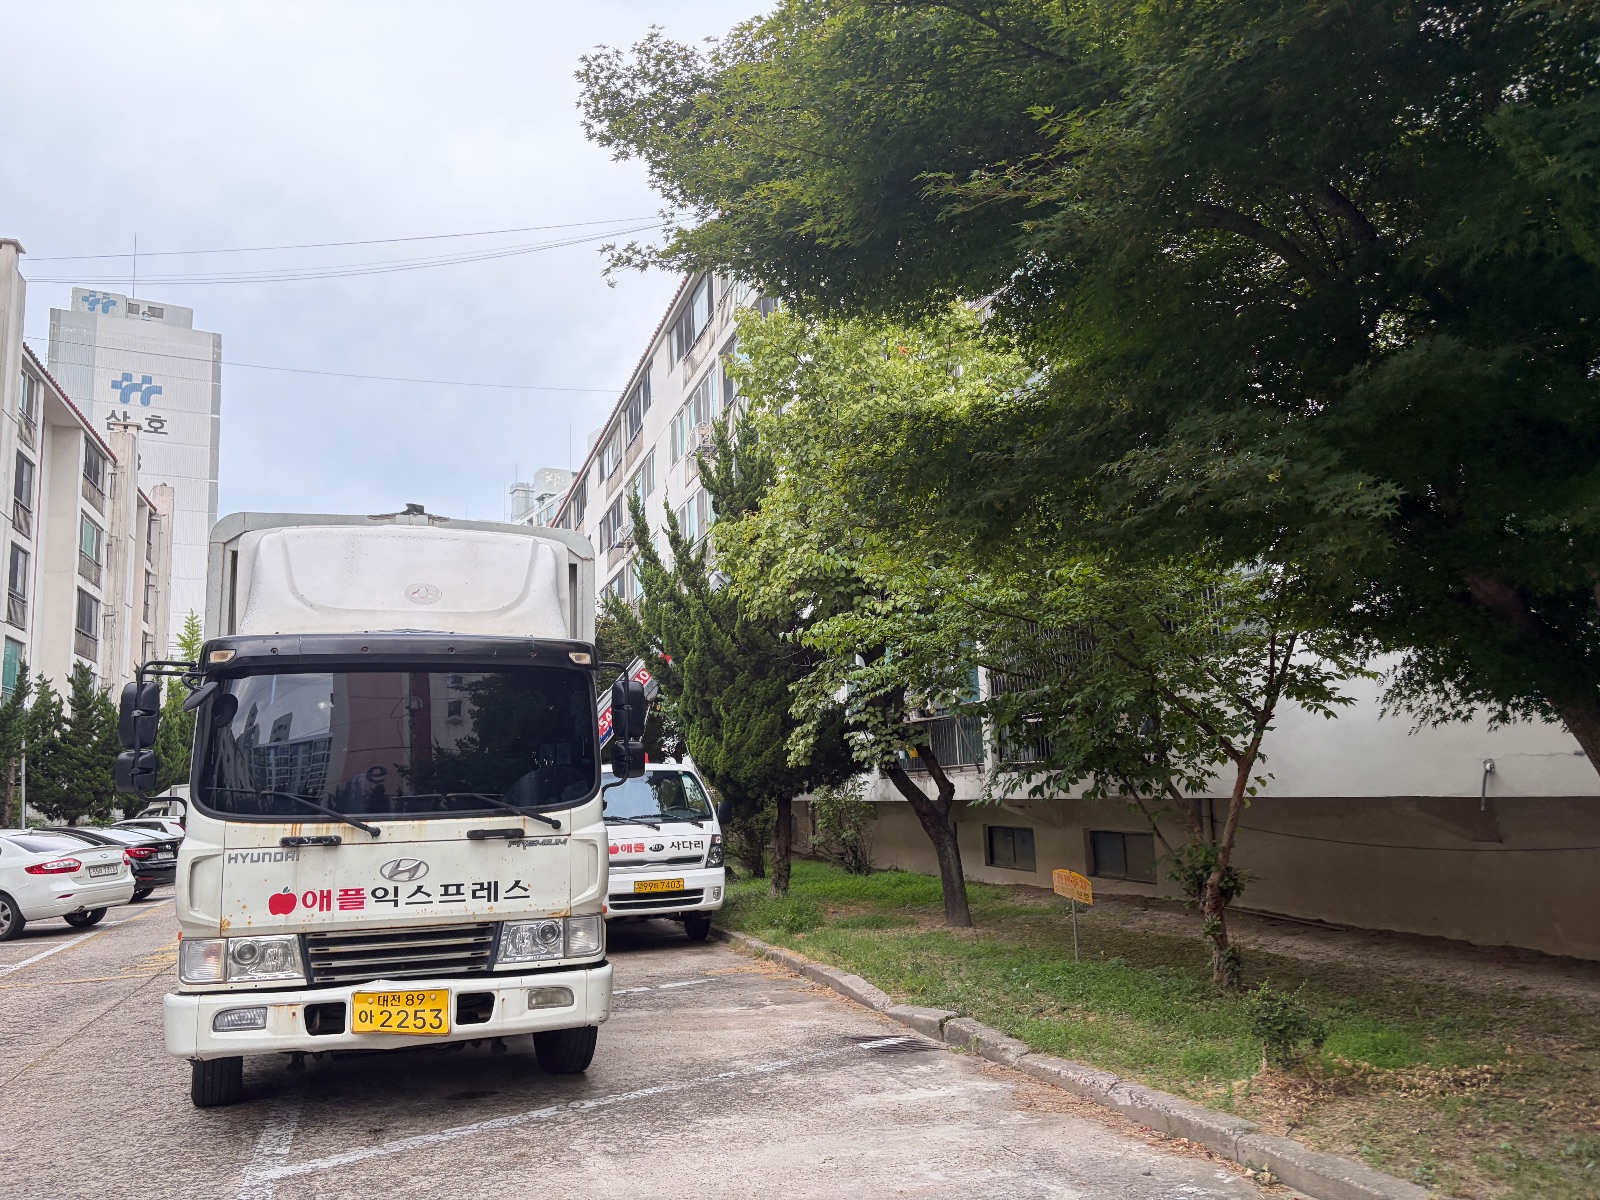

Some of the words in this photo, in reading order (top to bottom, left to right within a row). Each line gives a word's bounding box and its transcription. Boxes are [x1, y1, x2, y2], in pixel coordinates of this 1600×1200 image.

[508, 837, 569, 850] PREMIUM
[670, 840, 704, 850] 사다리
[227, 850, 300, 864] HYUNDAI
[377, 994, 400, 1007] 대전
[405, 993, 426, 1006] 89
